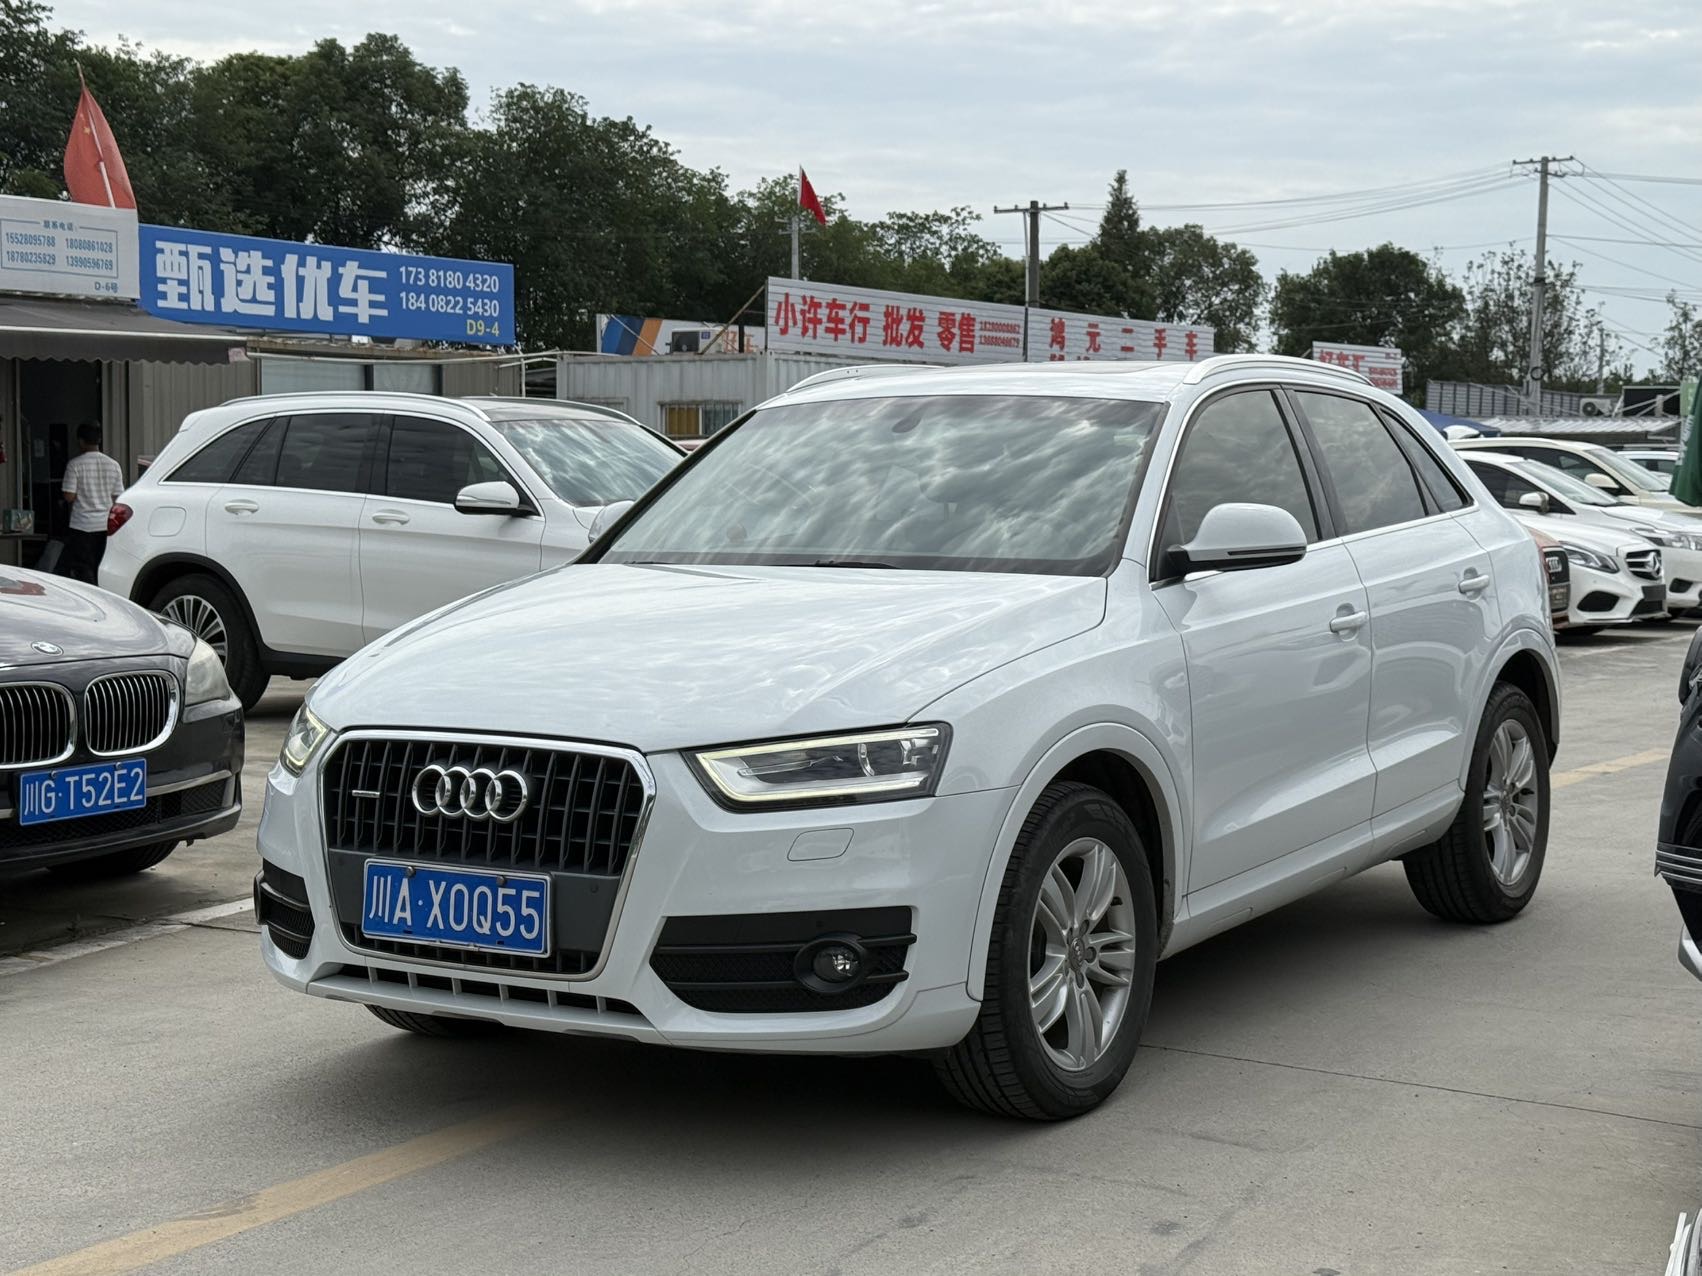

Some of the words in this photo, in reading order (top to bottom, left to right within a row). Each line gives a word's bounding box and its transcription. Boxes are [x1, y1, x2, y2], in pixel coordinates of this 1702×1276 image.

[155, 240, 389, 324] 甄选优车
[399, 265, 426, 287] 173
[428, 268, 463, 291] 8180
[465, 271, 499, 293] 4320
[399, 291, 426, 311] 184
[428, 294, 463, 314] 0822
[466, 297, 499, 317] 5430
[466, 319, 500, 337] D9-4
[774, 292, 871, 344] 小许车行
[882, 304, 926, 349] 批发
[936, 311, 976, 354] 零售
